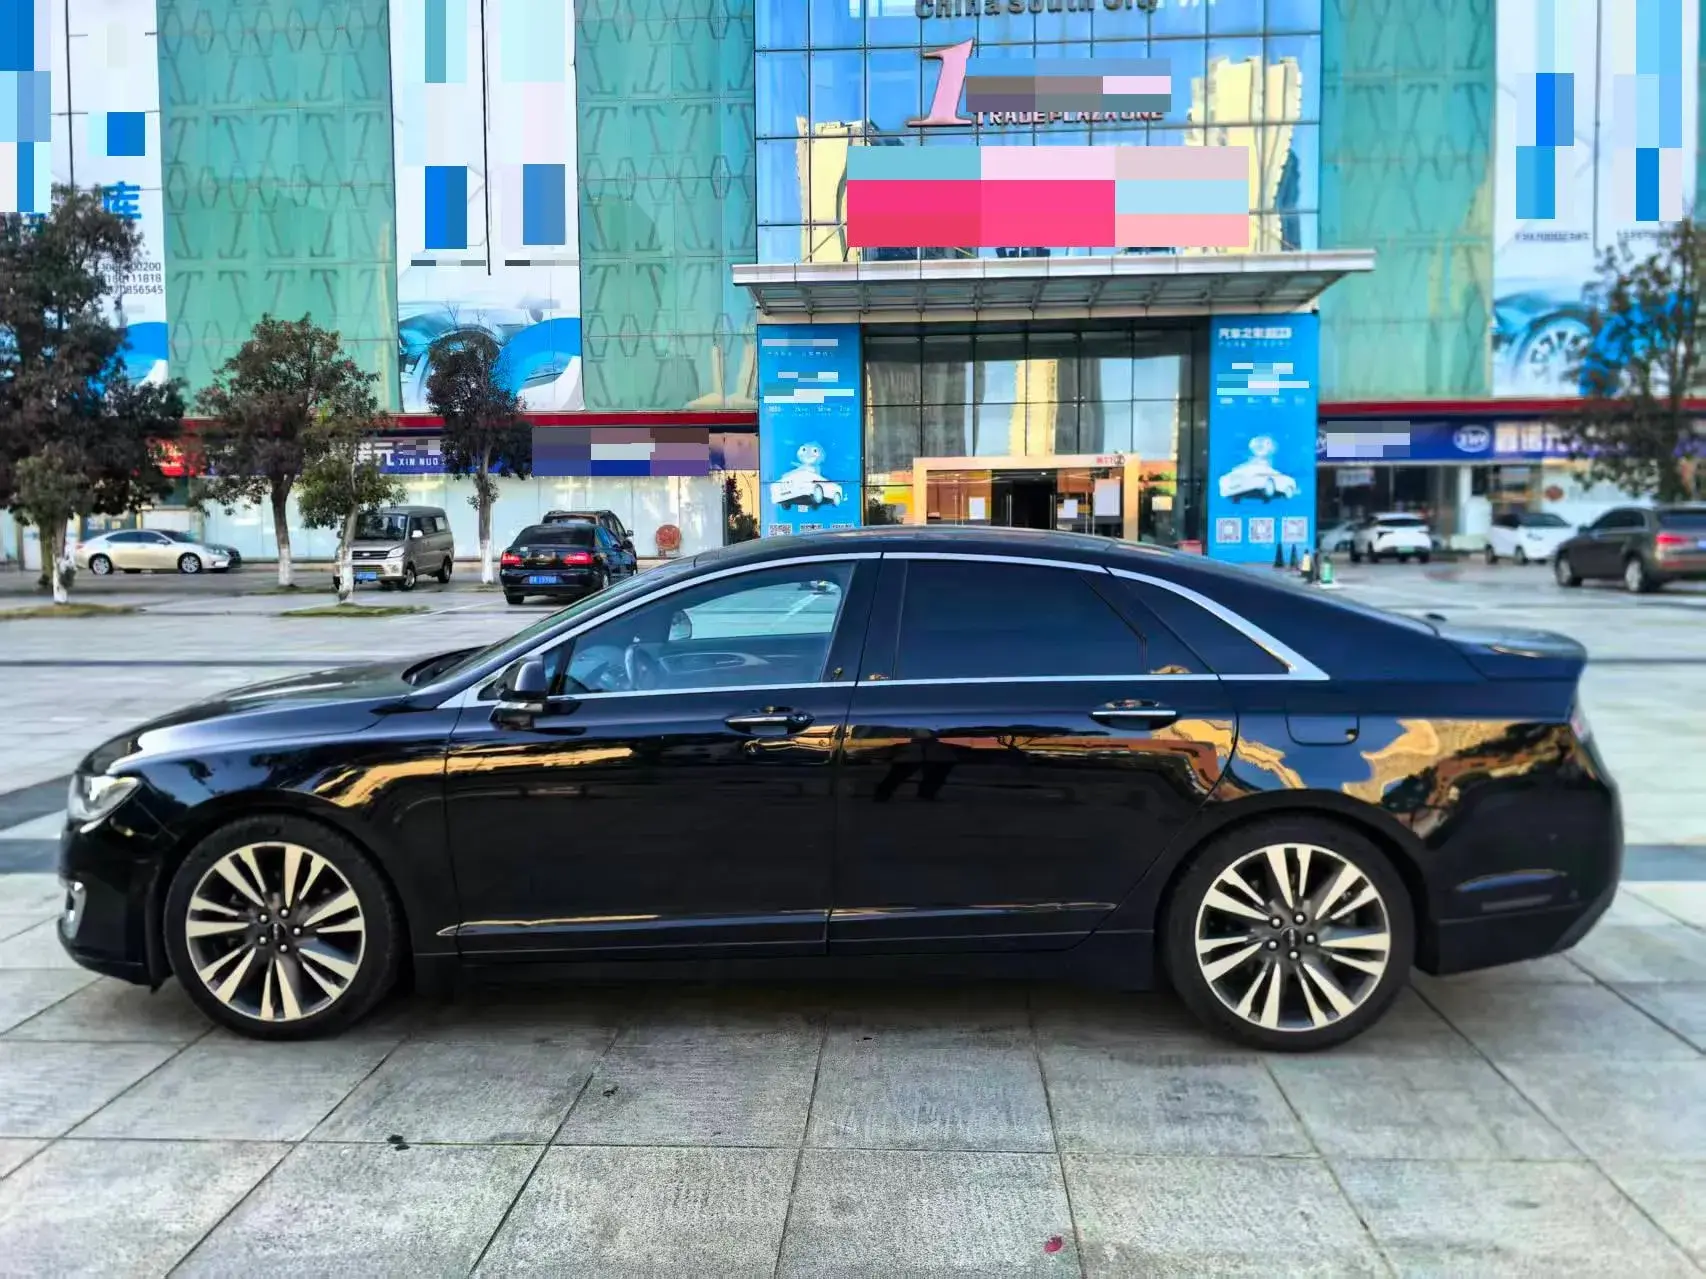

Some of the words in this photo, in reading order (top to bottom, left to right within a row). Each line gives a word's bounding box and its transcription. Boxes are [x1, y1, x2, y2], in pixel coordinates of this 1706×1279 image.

[907, 38, 975, 128] 1
[399, 458, 416, 467] XIN
[419, 457, 439, 466] NUO
